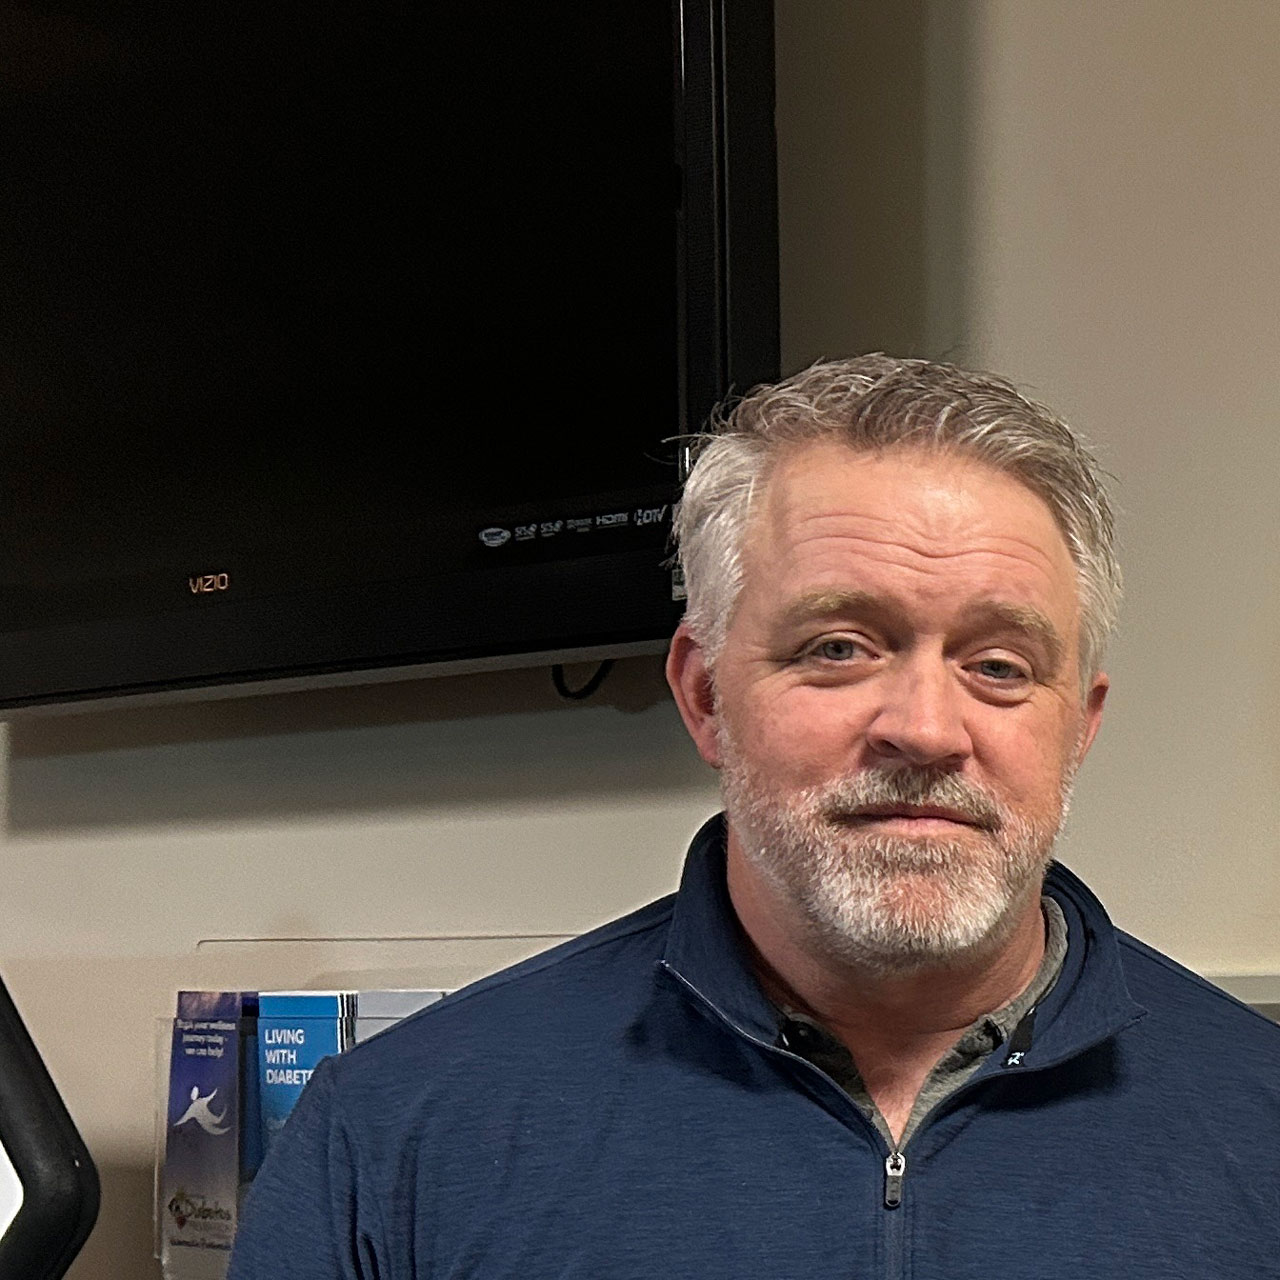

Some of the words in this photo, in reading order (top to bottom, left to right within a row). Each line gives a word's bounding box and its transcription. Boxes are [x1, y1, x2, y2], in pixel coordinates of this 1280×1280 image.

[189, 573, 228, 593] VIZIO
[264, 1028, 305, 1045] LIVING
[265, 1048, 297, 1065] WITH
